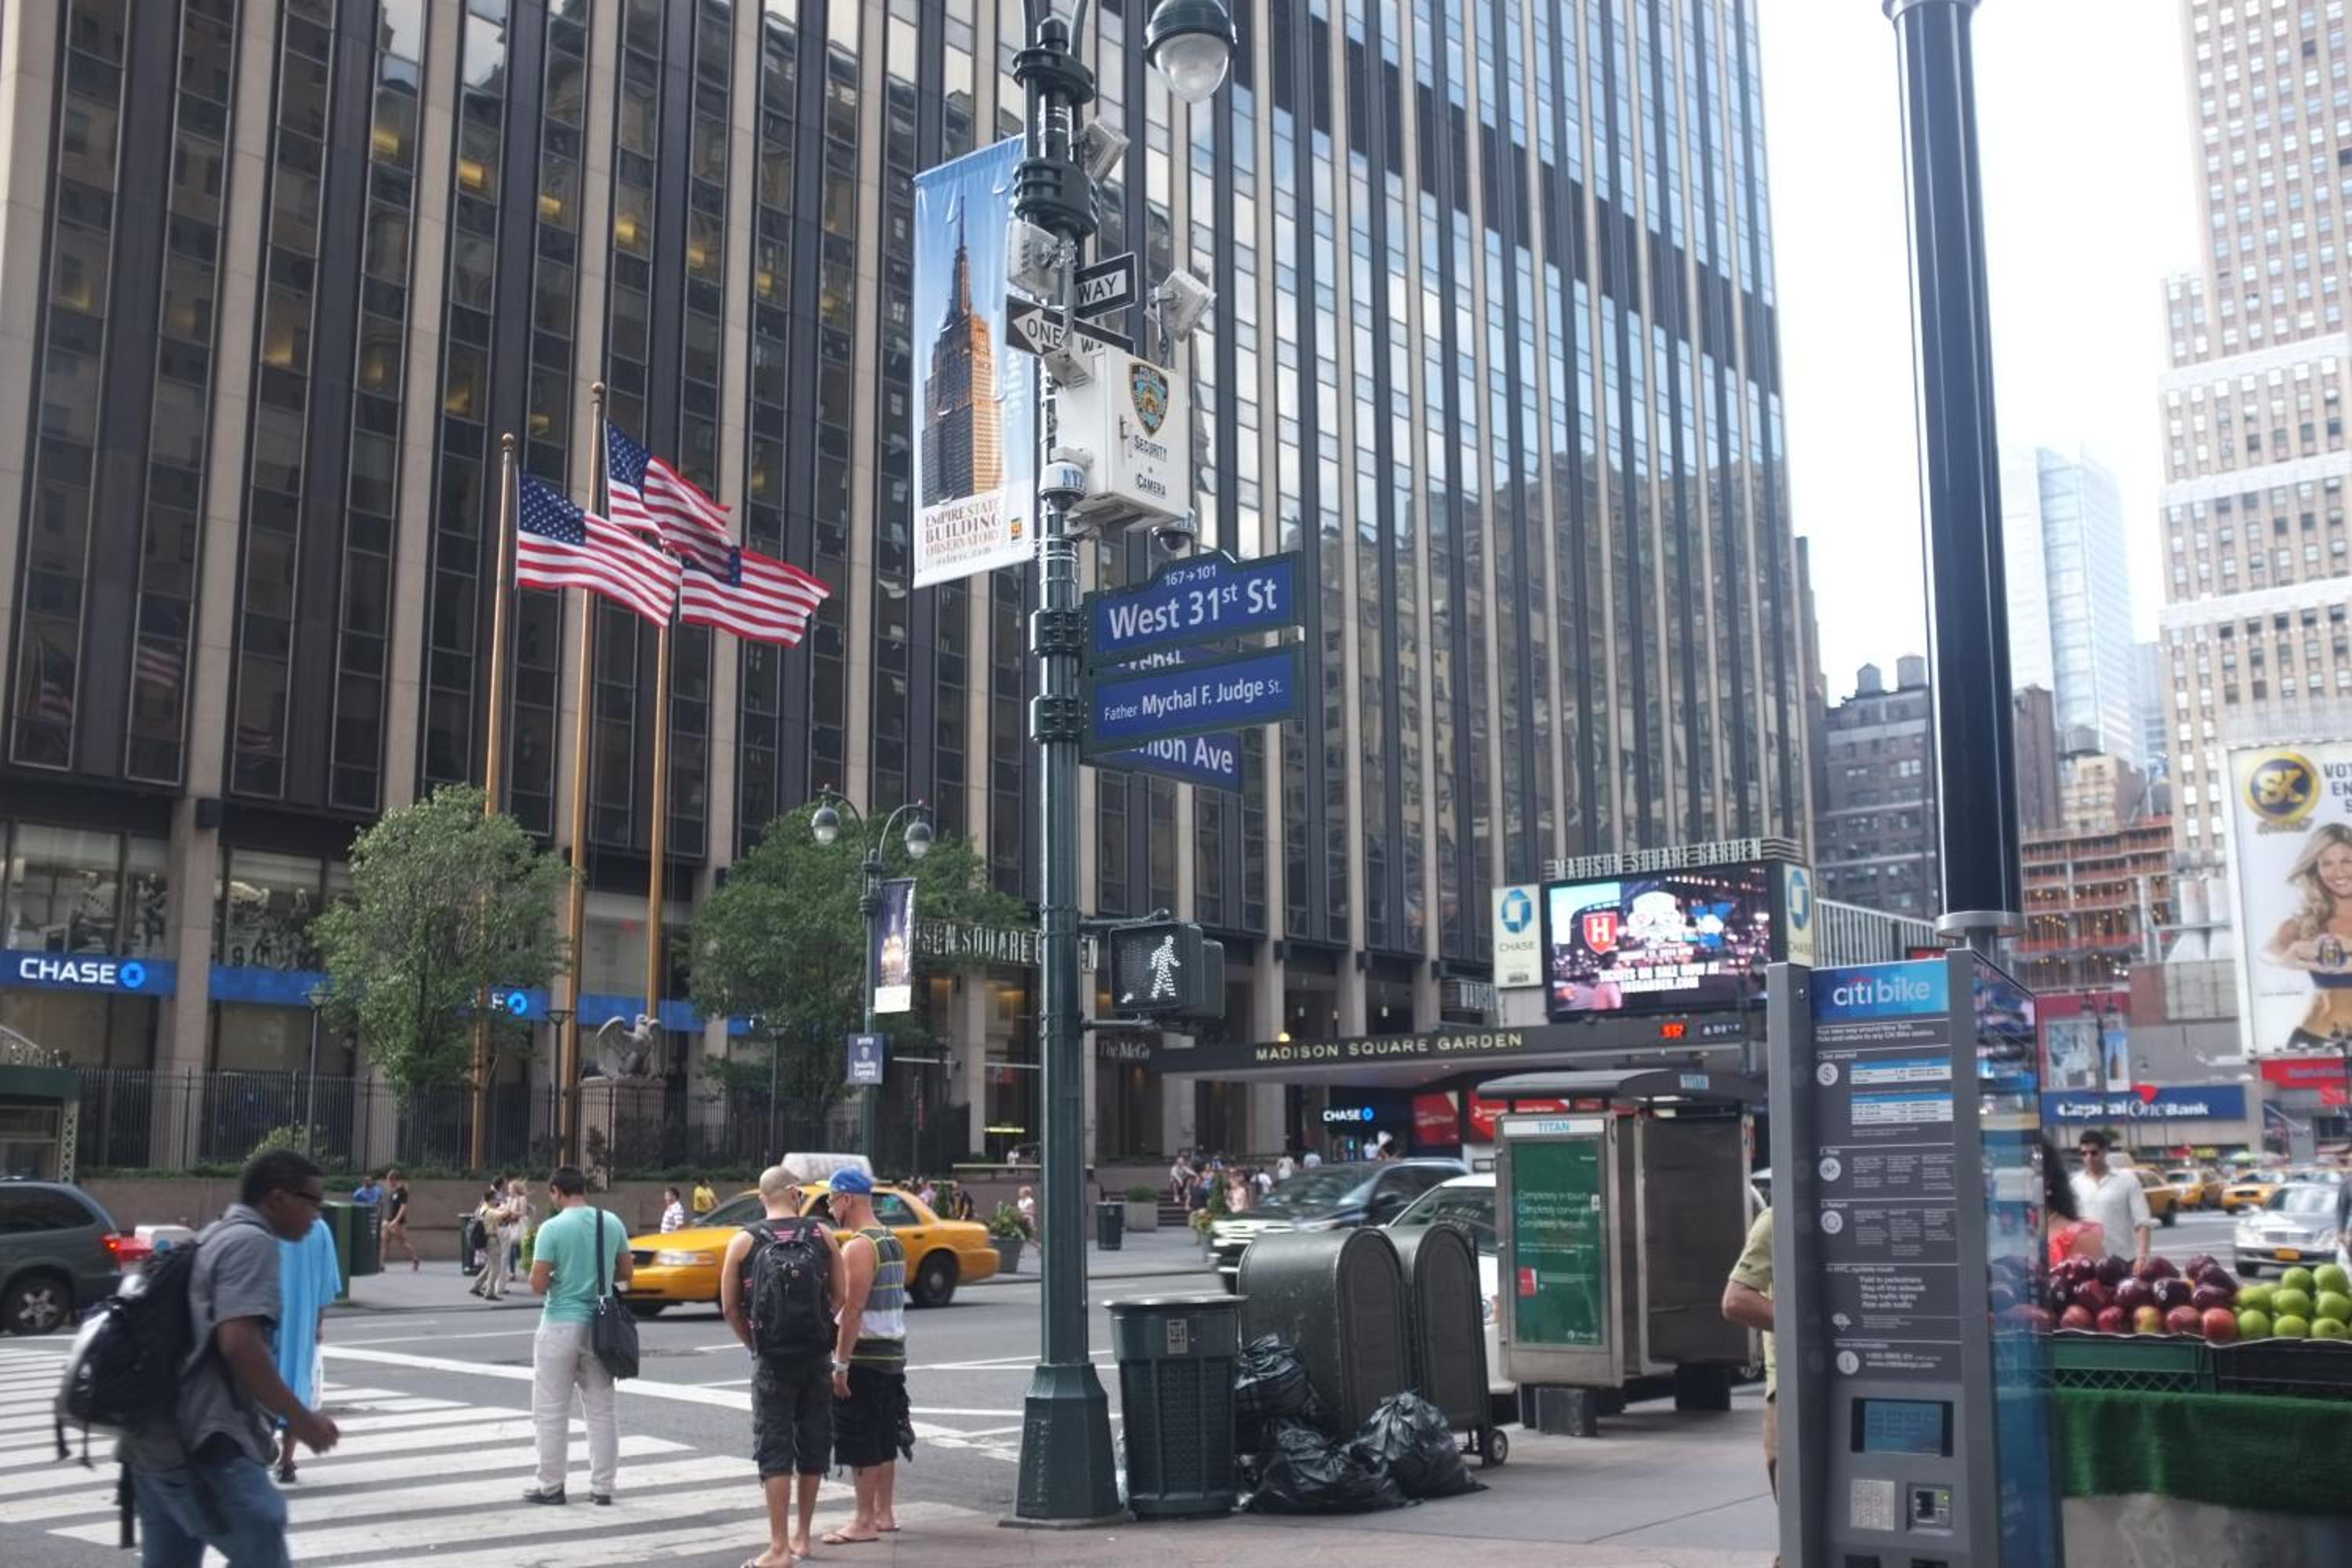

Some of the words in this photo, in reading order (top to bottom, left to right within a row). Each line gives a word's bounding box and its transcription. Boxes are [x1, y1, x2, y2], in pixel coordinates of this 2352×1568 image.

[1078, 274, 1117, 304] WAY
[1026, 318, 1063, 348] ONE
[1134, 435, 1167, 463] SECURITY
[1137, 473, 1166, 497] CAMERA
[926, 506, 964, 527] EMPIRE
[926, 513, 1001, 543] BUILDING
[926, 530, 1000, 557] OBSERVATORY
[1165, 570, 1185, 586] 167
[1196, 564, 1217, 579] 101
[1109, 597, 1180, 640] West
[1189, 583, 1238, 626] 31st
[1247, 577, 1277, 614] St
[1104, 705, 1138, 721] Father
[1142, 686, 1196, 718] Mychal
[1202, 684, 1212, 705] F.
[1216, 678, 1264, 704] Judge
[1193, 737, 1233, 774] Ave
[1555, 854, 1623, 880] MADISON
[1631, 845, 1690, 870] SQUARE
[1698, 838, 1762, 865] GARDEN
[962, 927, 1029, 963] SQUARE
[1498, 941, 1537, 953] CHASE
[20, 958, 116, 985] CHASE
[1832, 981, 1872, 1006] citi
[1877, 977, 1931, 1004] bike
[1256, 1044, 1339, 1061] MADISON
[1348, 1038, 1428, 1056] SQUARE
[1437, 1033, 1523, 1051] GARDEN
[1323, 1109, 1361, 1122] CHASE
[2165, 1101, 2209, 1116] Bank
[1537, 1121, 1570, 1133] TITAN
